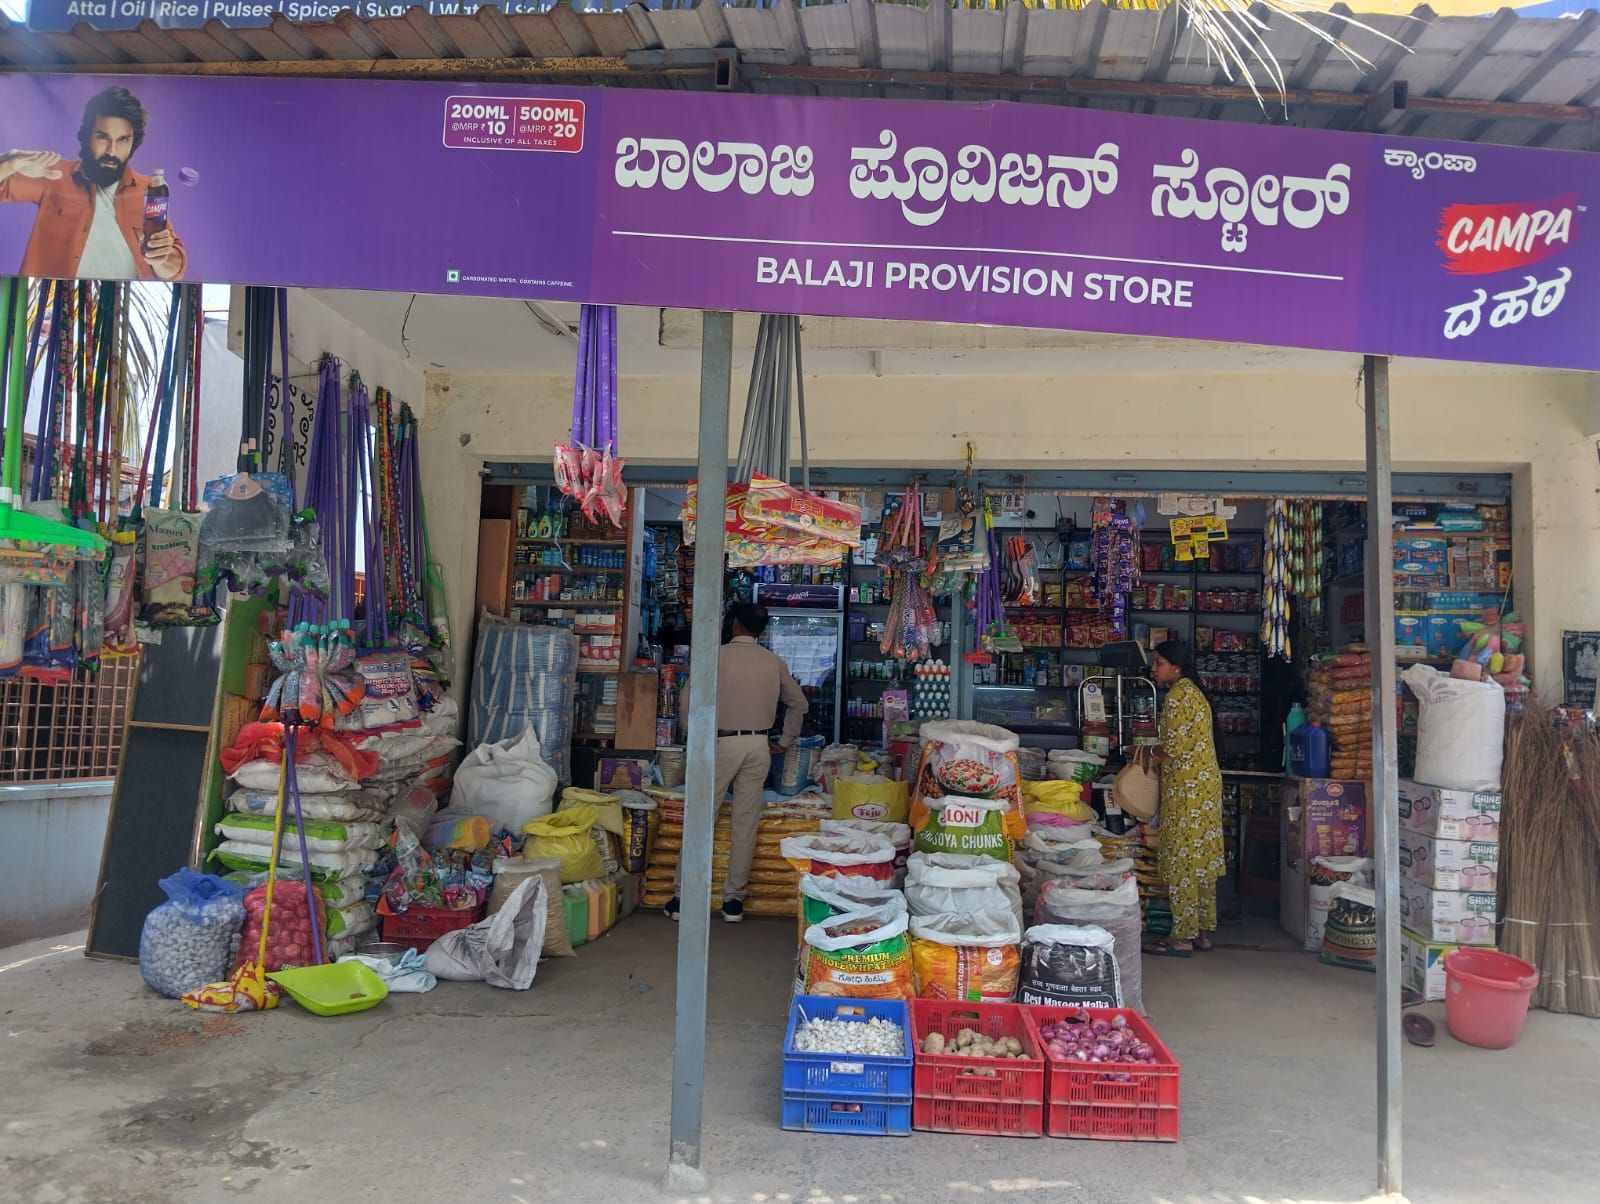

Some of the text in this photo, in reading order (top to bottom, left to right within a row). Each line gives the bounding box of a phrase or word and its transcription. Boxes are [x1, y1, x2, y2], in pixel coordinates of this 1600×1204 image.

[67, 1, 106, 17] Atta
[120, 1, 145, 17] Oil
[159, 1, 199, 17] Rice
[213, 1, 272, 18] Pulses
[451, 104, 579, 122] 200ML 500ML
[451, 122, 479, 132] @MRP
[519, 124, 546, 134] @MRP
[463, 136, 503, 144] INCLUSIVE
[1383, 148, 1478, 180] ಕ್ಯಾಂಪಾ
[614, 137, 815, 197] ಬಾಲಾಜಿ
[1151, 148, 1351, 253] ಸ್ಟೋರ್
[1447, 207, 1573, 254] CAMPA
[756, 257, 1194, 308] BALAJI PROVISION STORE
[940, 808, 979, 824] LONI
[632, 826, 645, 857] Cycle
[933, 832, 957, 849] SOYA
[962, 833, 1004, 849] CHUNKS
[816, 953, 846, 970] WHOLE
[848, 962, 888, 972] WHEAT
[841, 952, 890, 963] PREMIUM
[1023, 991, 1041, 1004] Best
